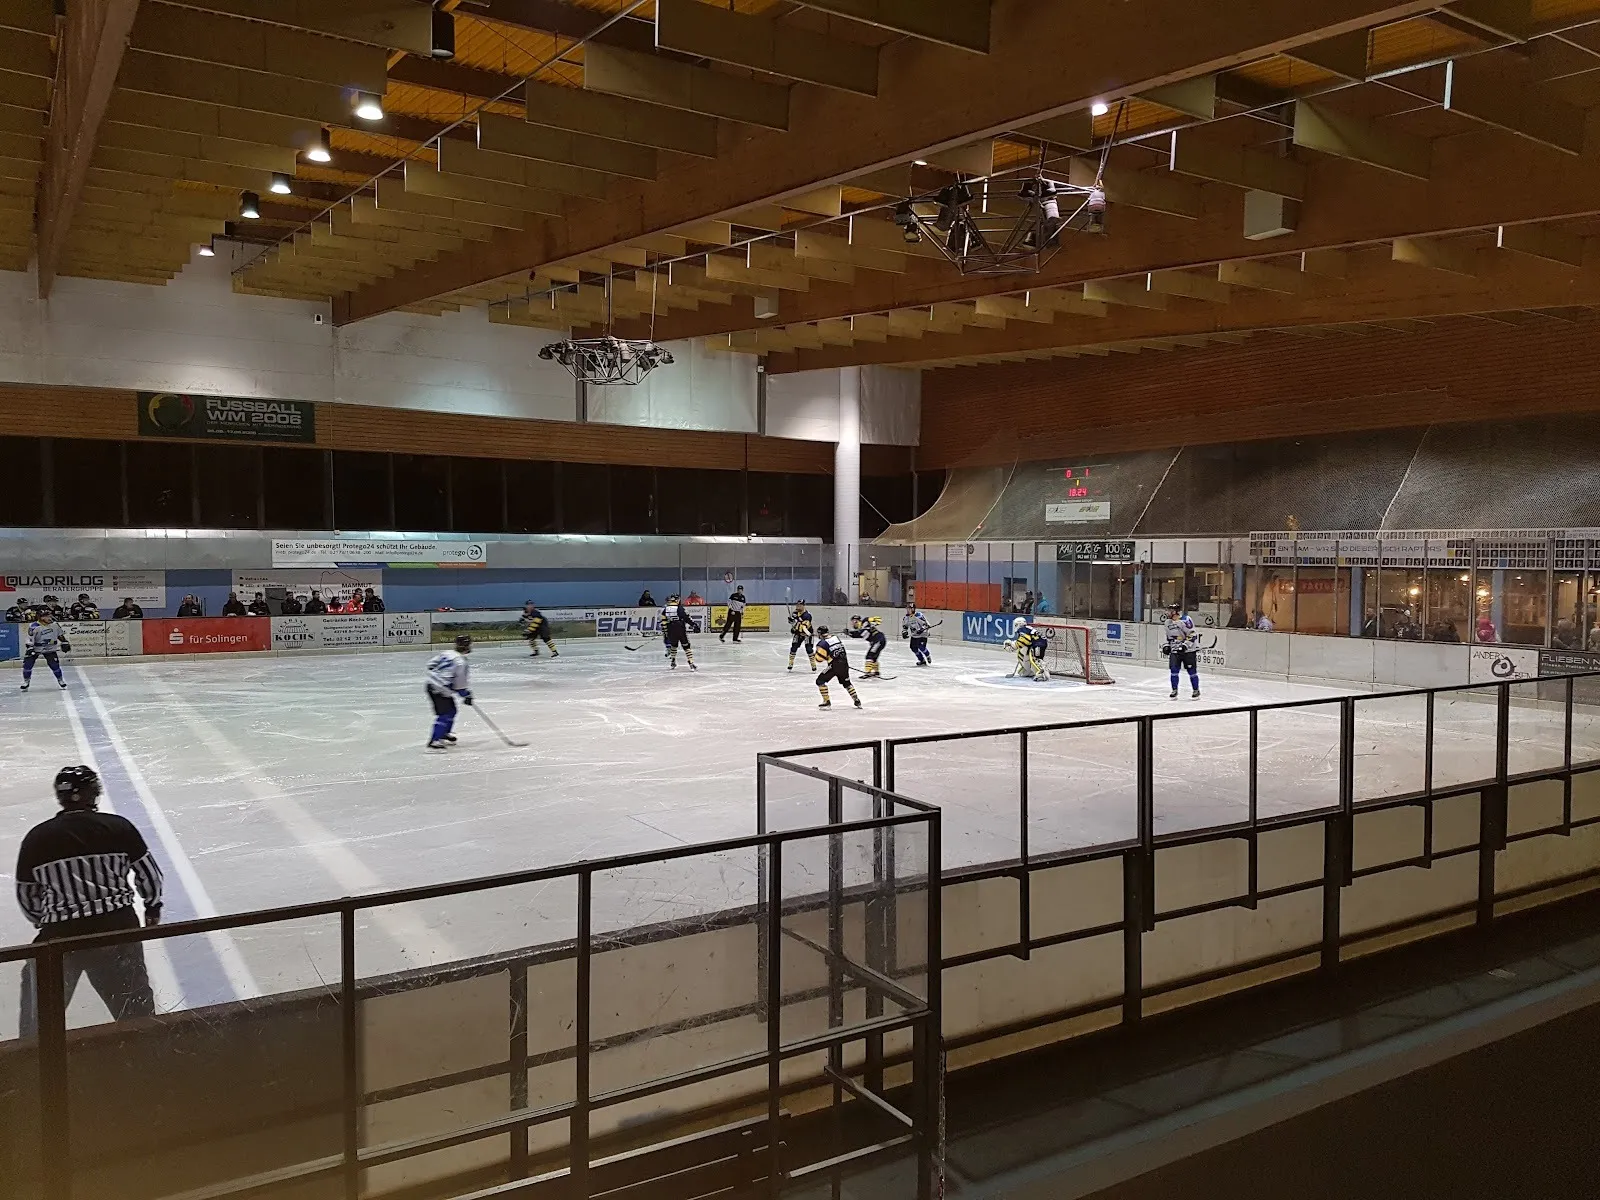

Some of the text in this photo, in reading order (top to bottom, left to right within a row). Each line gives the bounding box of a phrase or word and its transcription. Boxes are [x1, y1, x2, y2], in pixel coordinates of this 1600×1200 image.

[206, 399, 301, 414] FUSSBALL
[206, 410, 302, 425] WM 2006
[306, 542, 341, 550] unbesorgt!
[342, 543, 375, 551] Protego24
[442, 549, 466, 557] protego
[6, 575, 103, 587] QUADRILOG
[274, 633, 314, 641] KOCHS
[388, 629, 424, 637] KOCHS
[189, 634, 203, 644] für
[205, 634, 248, 645] Solingen
[1202, 655, 1211, 664] 96
[1212, 656, 1225, 665] 700
[1541, 653, 1590, 665] FLIESEN
